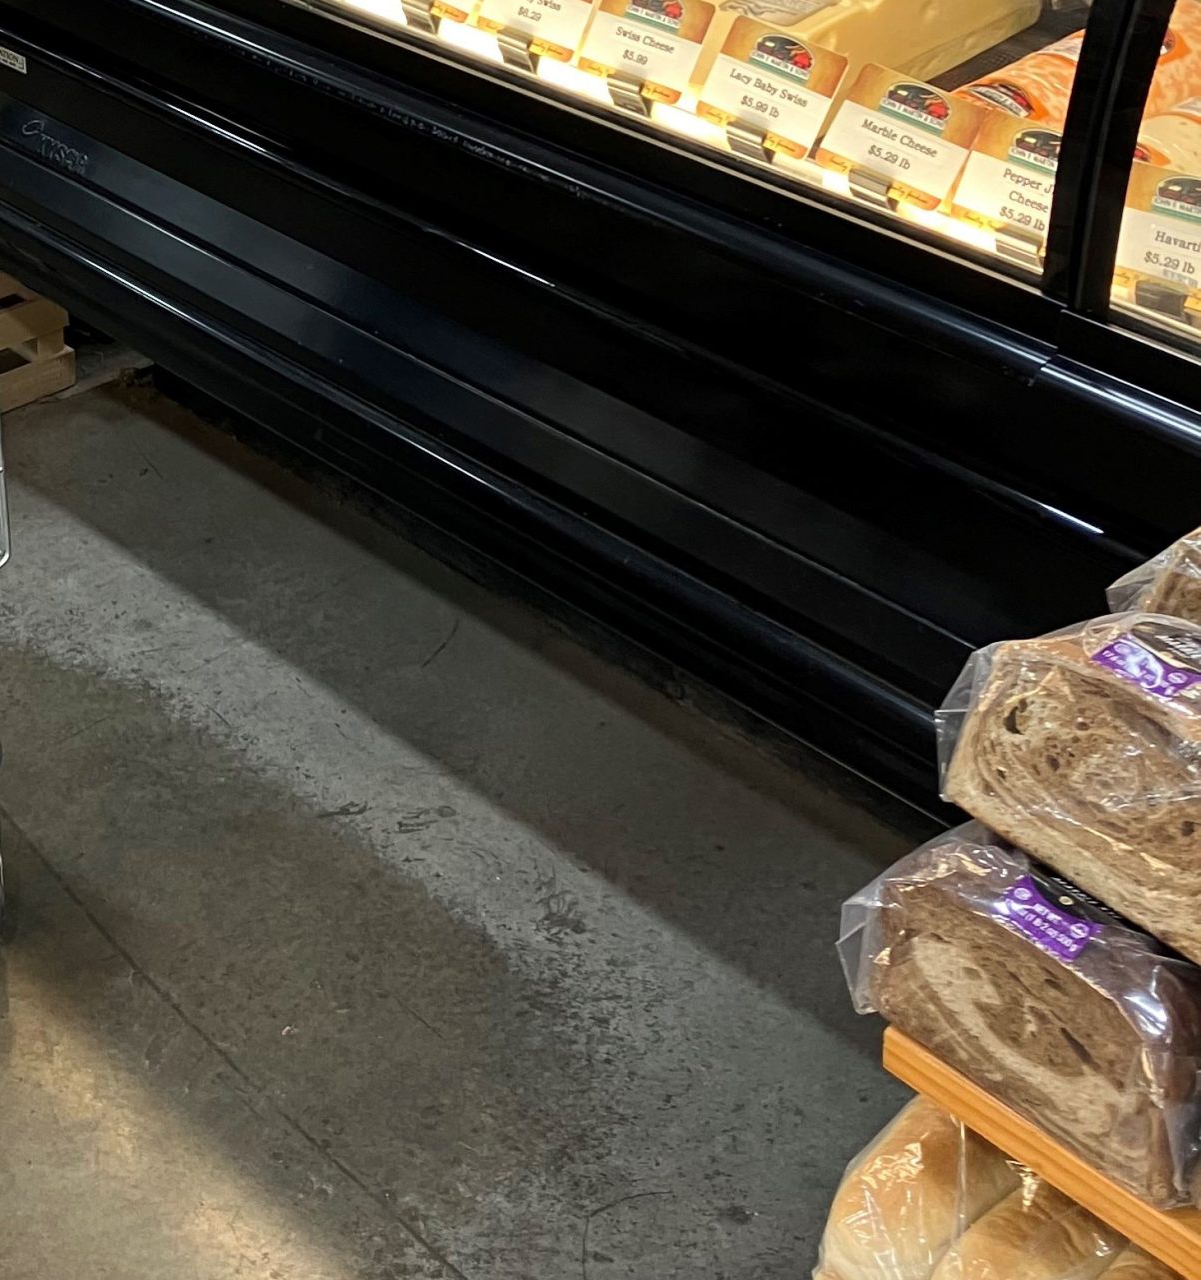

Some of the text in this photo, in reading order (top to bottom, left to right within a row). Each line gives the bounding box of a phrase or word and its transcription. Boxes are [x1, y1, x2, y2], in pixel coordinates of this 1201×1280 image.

[616, 25, 676, 55] Swiss Cheese
[729, 68, 808, 108] Lacy Baby Swiss
[860, 118, 939, 158] Marble Cheese
[867, 144, 911, 170] $5.29 lb
[1003, 168, 1042, 193] Pepper
[1008, 190, 1050, 214] Cheese
[999, 205, 1046, 232] $5.29 lb
[1154, 229, 1201, 253] Havarti
[1144, 250, 1196, 274] $5.29 lb
